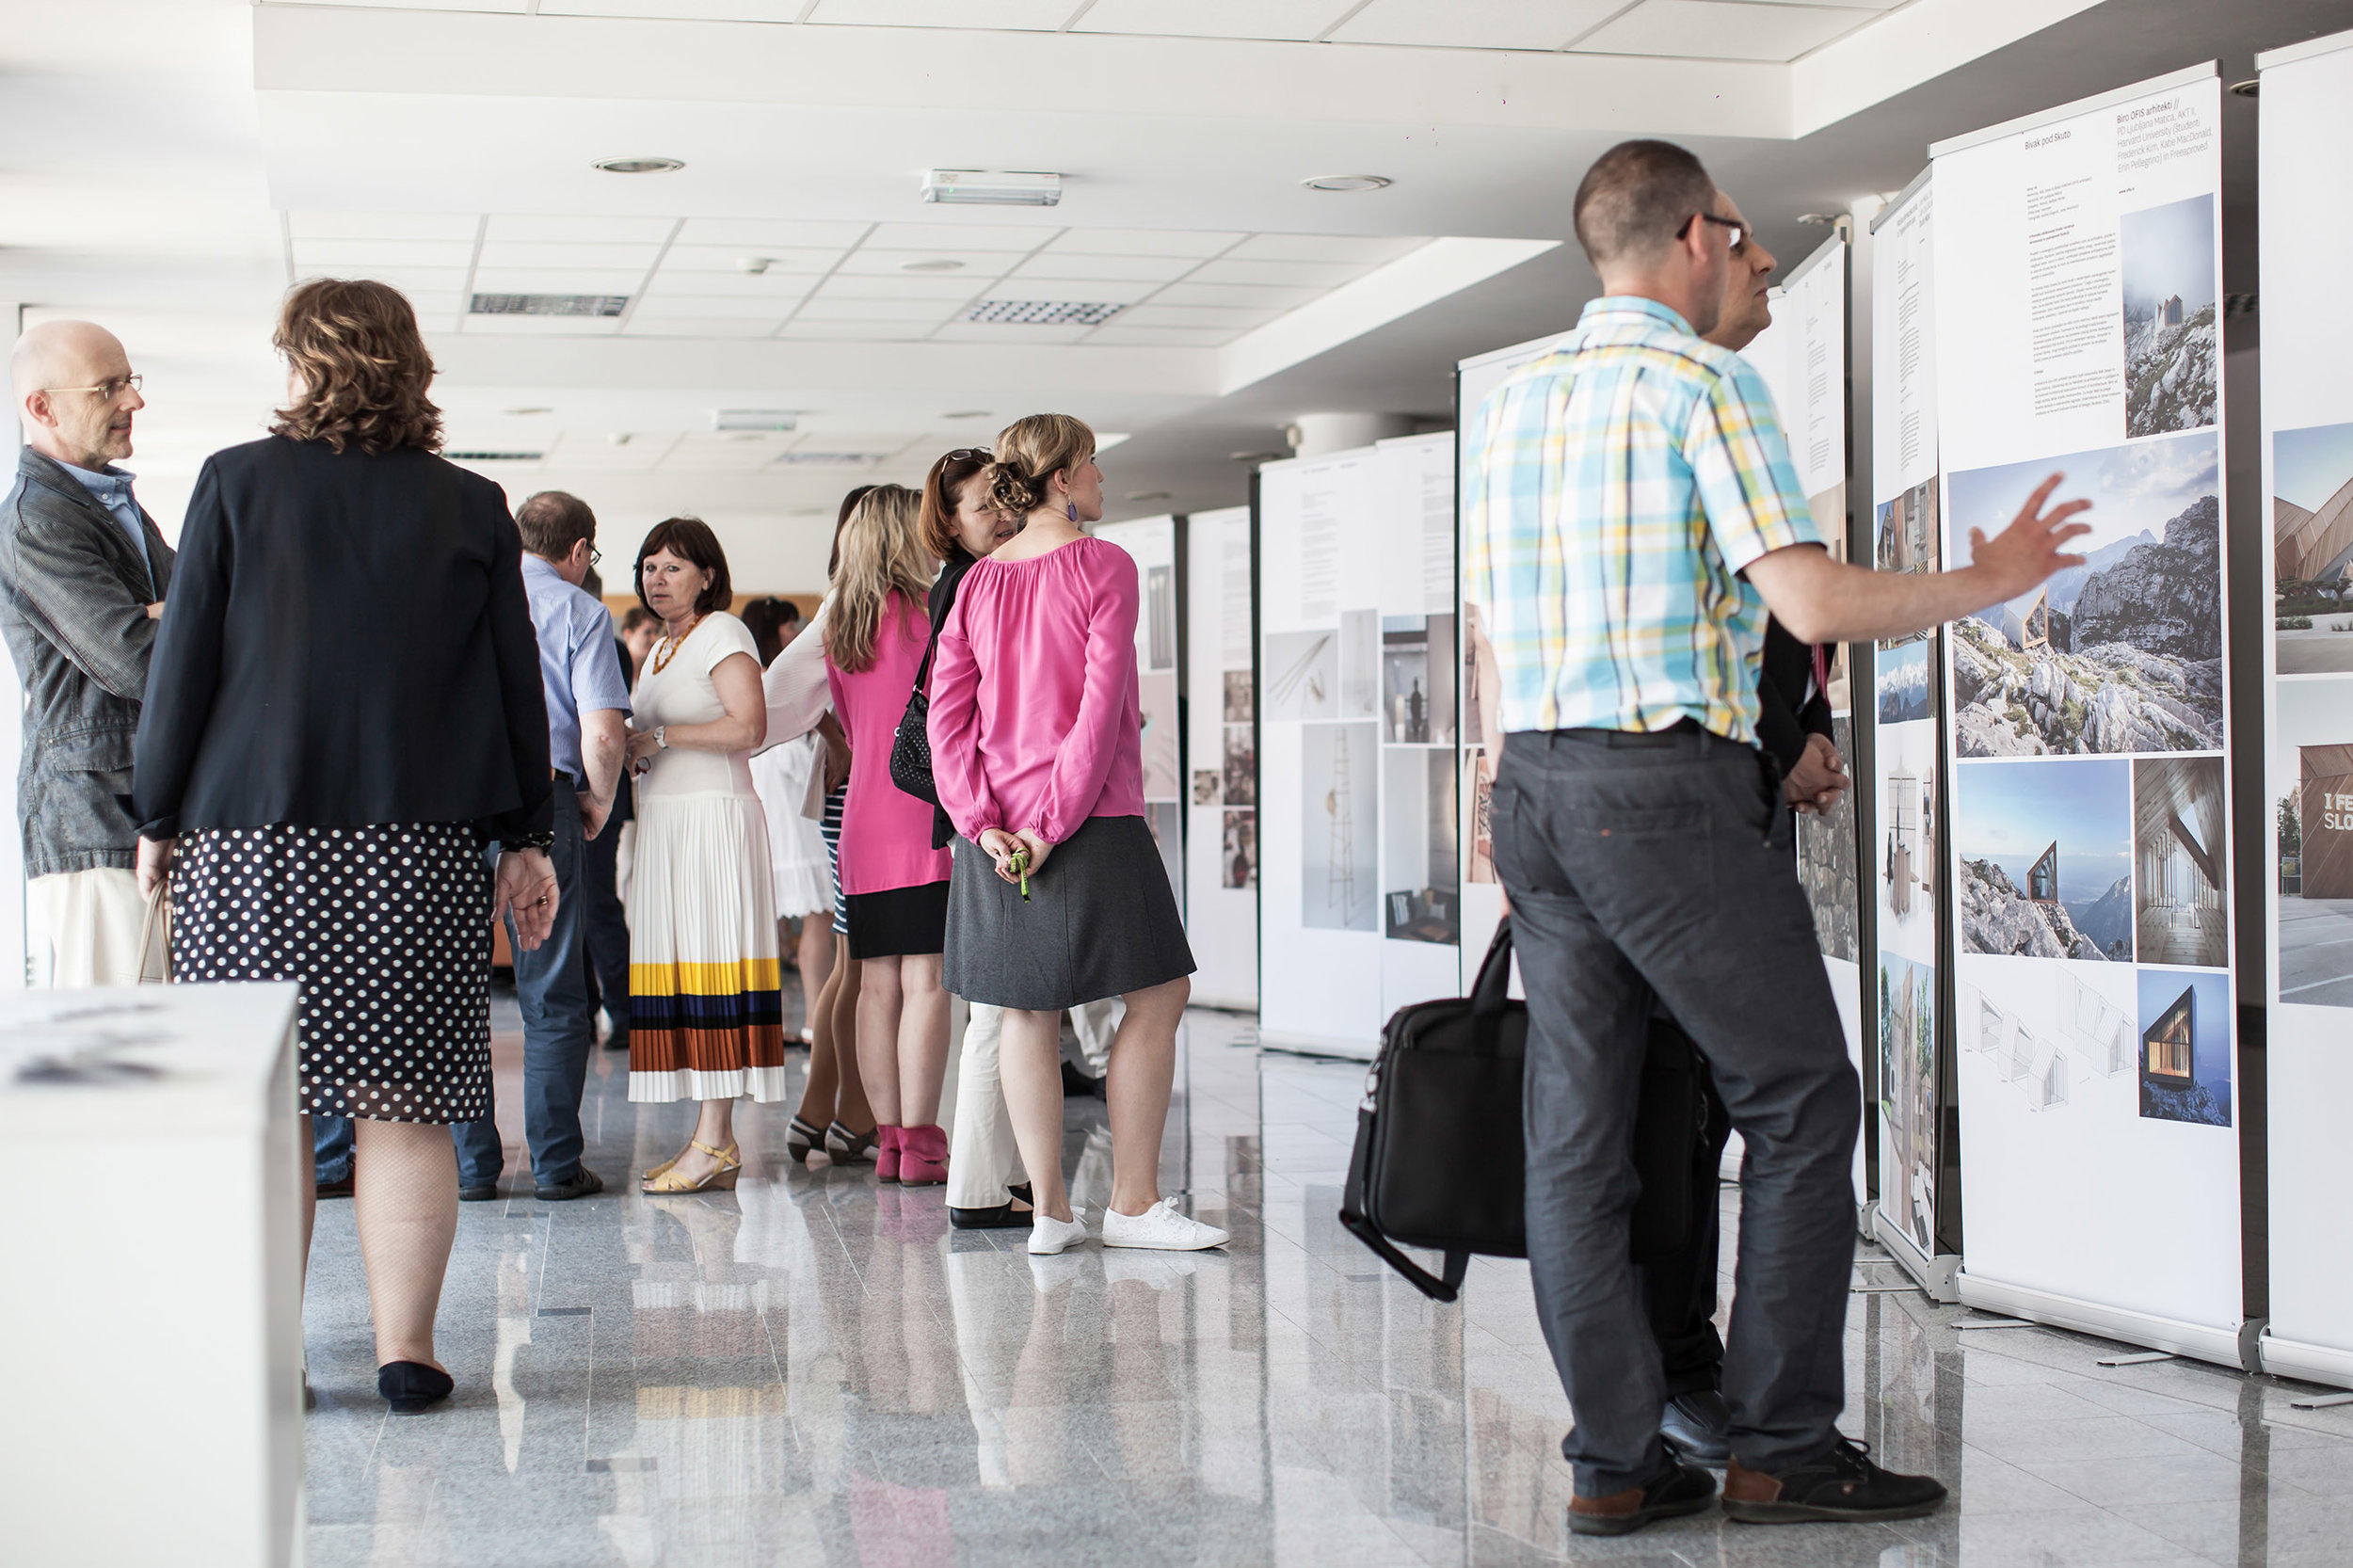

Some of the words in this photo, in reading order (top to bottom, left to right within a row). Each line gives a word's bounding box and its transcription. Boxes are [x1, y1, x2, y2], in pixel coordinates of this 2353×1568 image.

[2117, 113, 2130, 124] Biro
[2130, 108, 2145, 120] OFIS
[2146, 100, 2173, 116] arhitekti
[2025, 136, 2041, 150] Bivak
[2041, 134, 2053, 148] pod
[2054, 130, 2072, 142] Skuto
[2142, 127, 2172, 142] University
[2324, 792, 2332, 809] I
